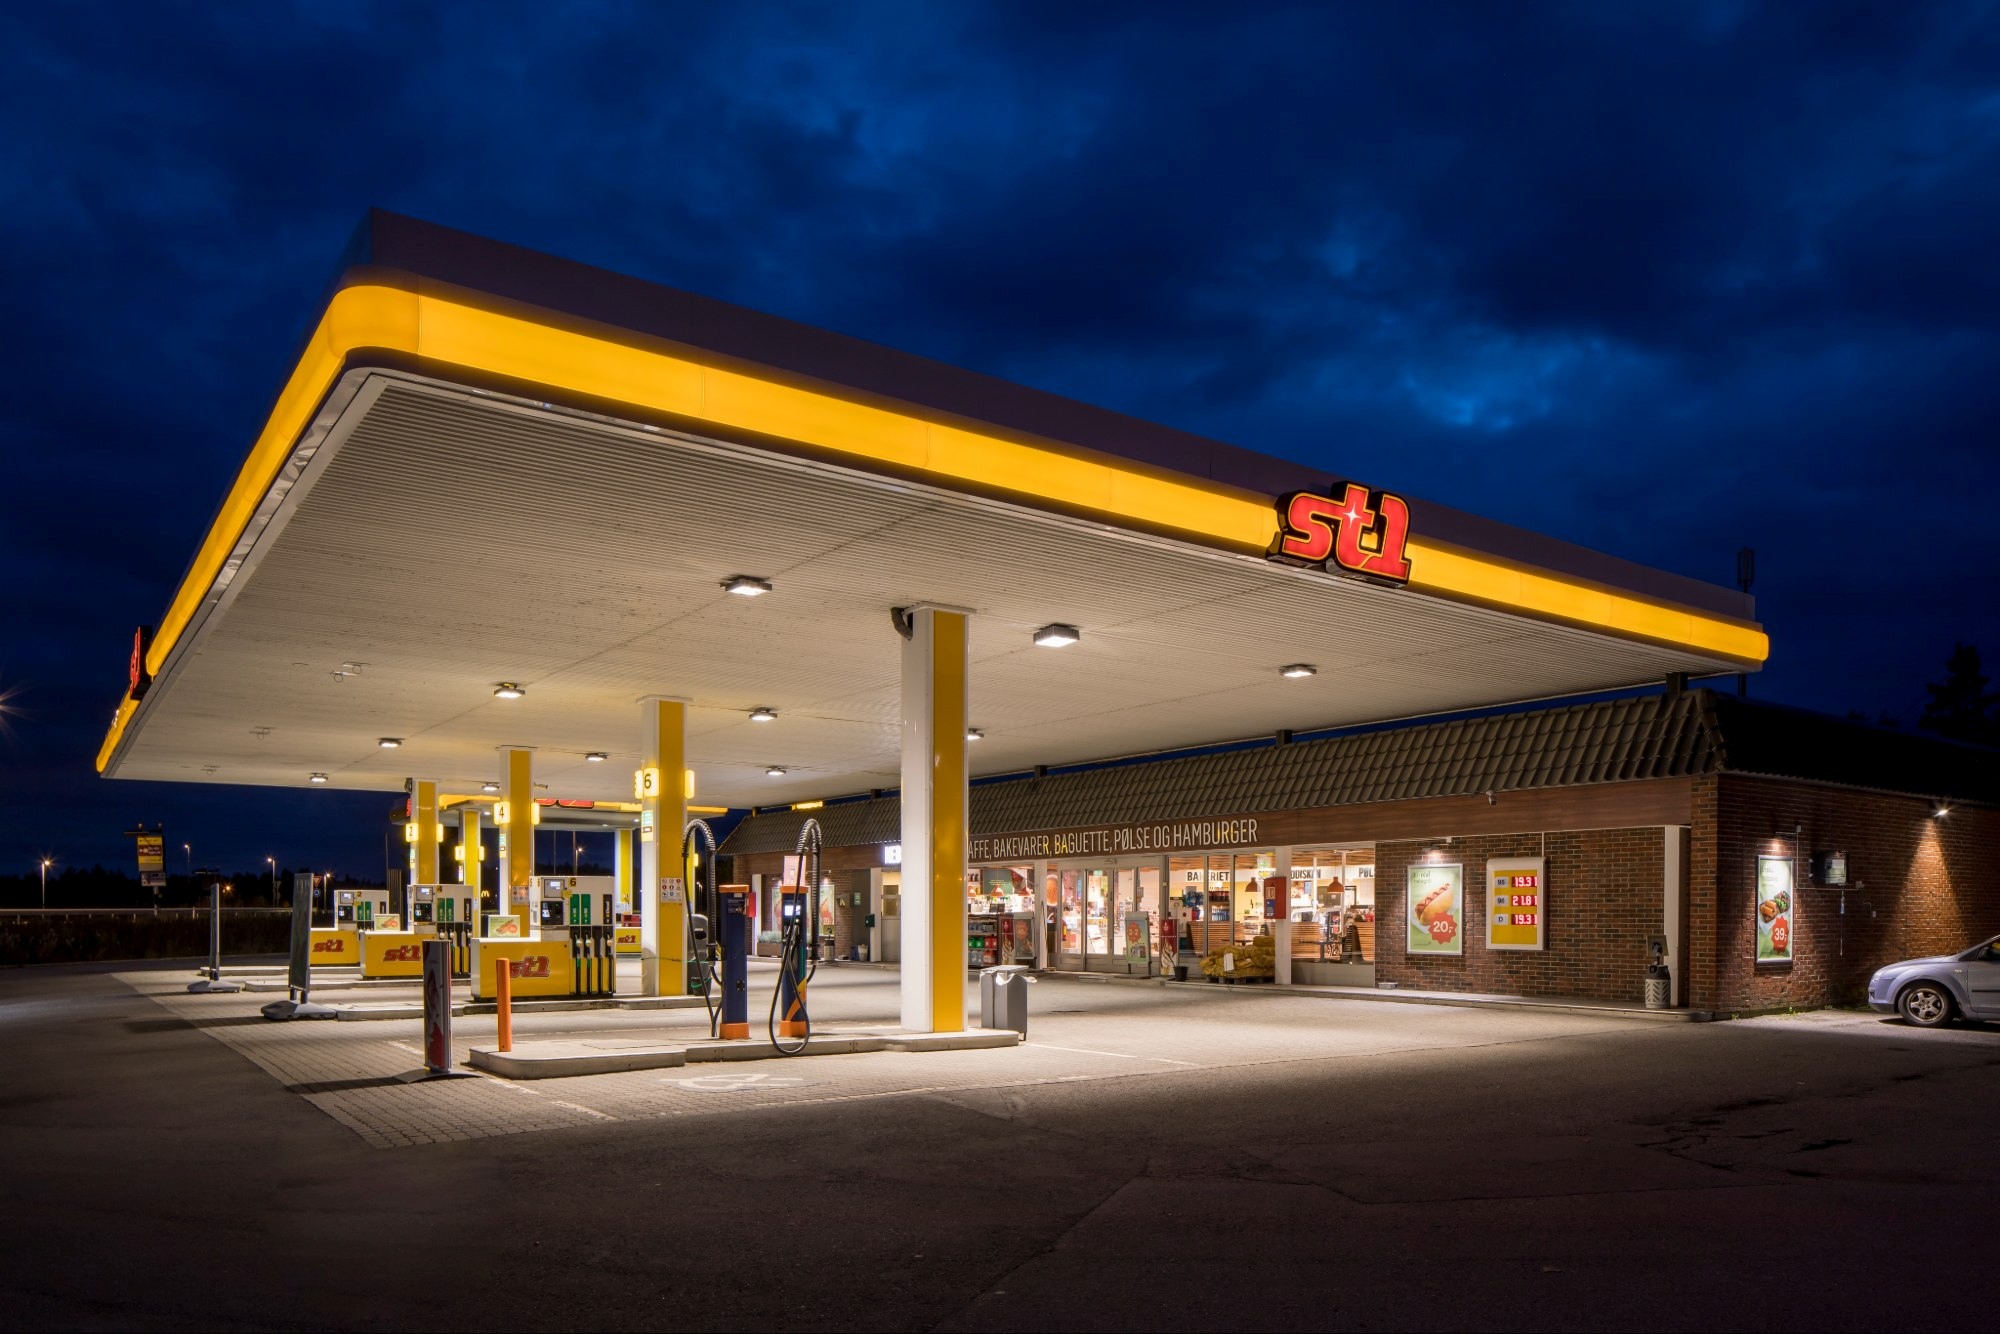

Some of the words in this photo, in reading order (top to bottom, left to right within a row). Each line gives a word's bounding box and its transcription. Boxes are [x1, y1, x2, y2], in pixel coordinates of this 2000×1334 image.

[1281, 483, 1410, 581] st1
[644, 773, 652, 789] 6
[499, 805, 505, 819] 4
[994, 835, 1052, 858] BAKEVARER,
[1054, 830, 1112, 854] BAGUETTE,
[1114, 827, 1150, 851] PØLSE
[1154, 825, 1170, 848] OG
[1173, 819, 1258, 847] HAMBURGER
[570, 877, 577, 887] 6
[1187, 871, 1230, 881] BARIET
[1514, 876, 1537, 887] 19.31
[1514, 914, 1537, 925] 19.31
[312, 939, 345, 953] st1
[383, 945, 421, 962] st1
[509, 955, 550, 979] st1
